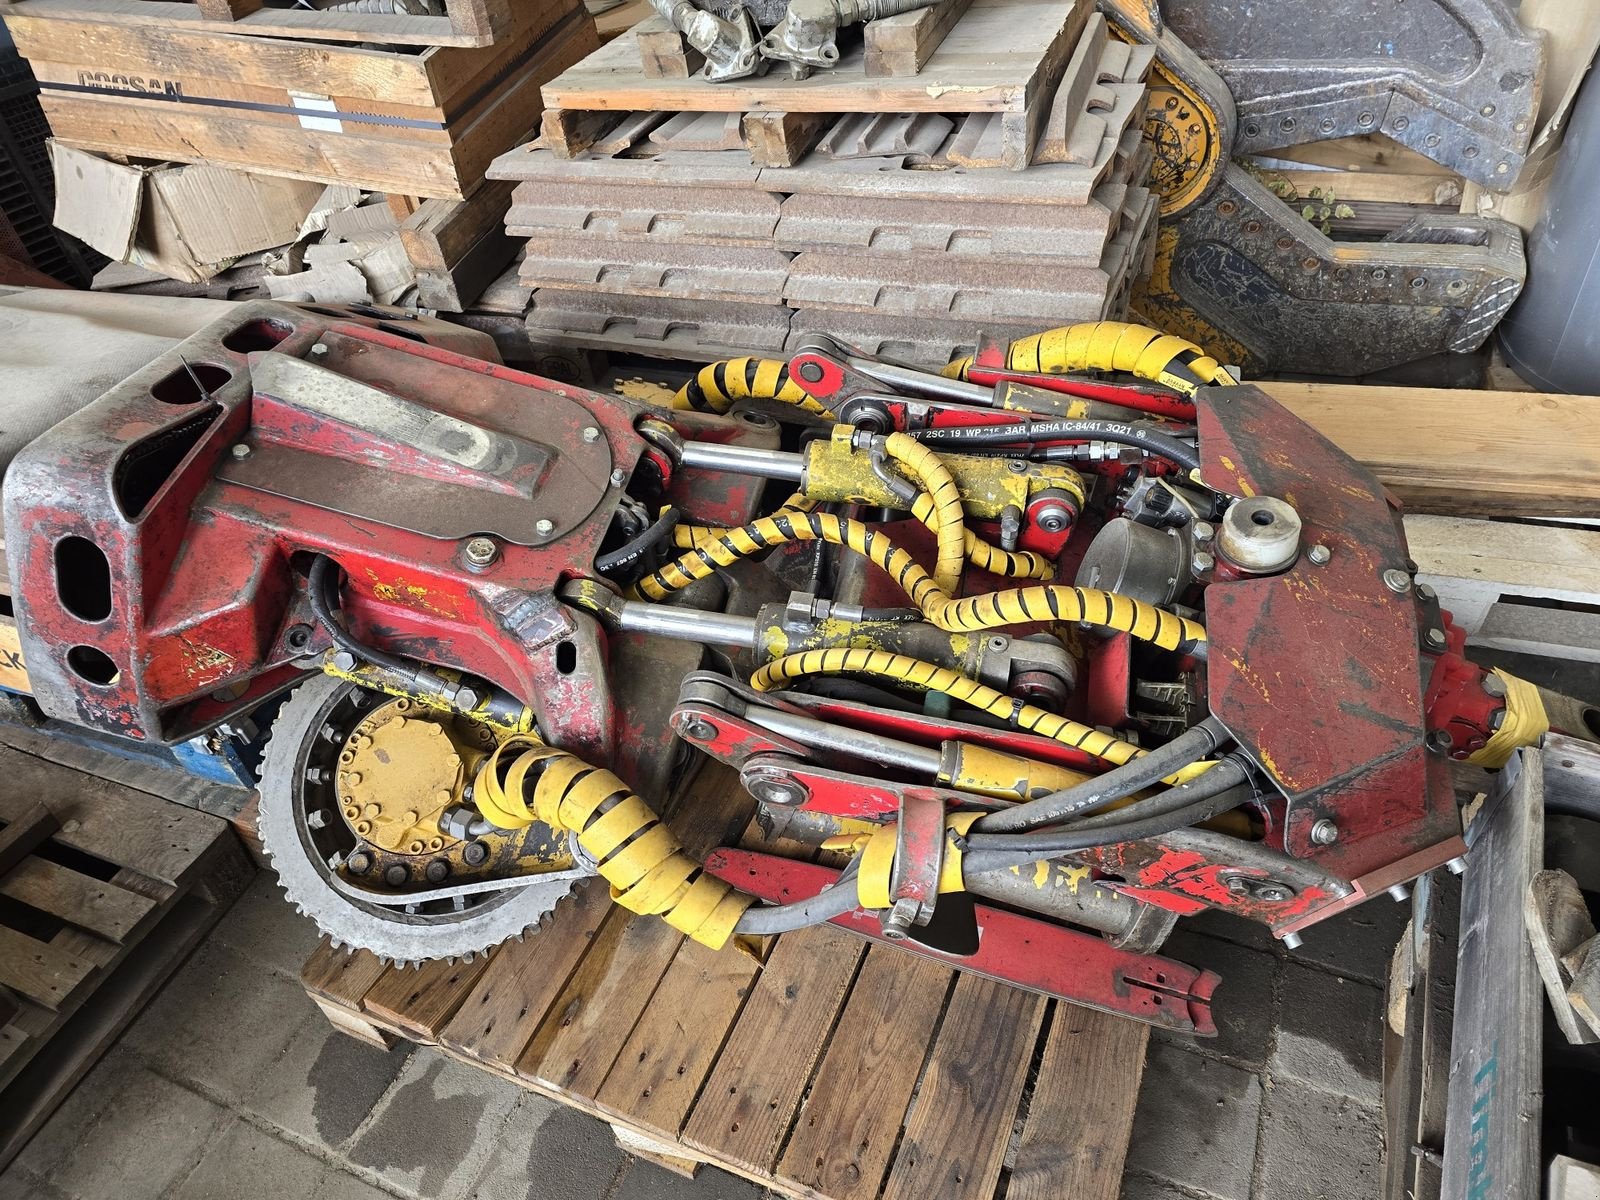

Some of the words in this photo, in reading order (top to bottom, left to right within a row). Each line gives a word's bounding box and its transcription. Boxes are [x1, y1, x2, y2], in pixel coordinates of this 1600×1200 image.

[926, 430, 945, 439] 2SC
[949, 429, 961, 438] 19
[965, 428, 982, 438] WP
[1030, 422, 1060, 433] MSHA
[1062, 422, 1101, 431] IC-84/41
[1105, 423, 1132, 435] 3Q21
